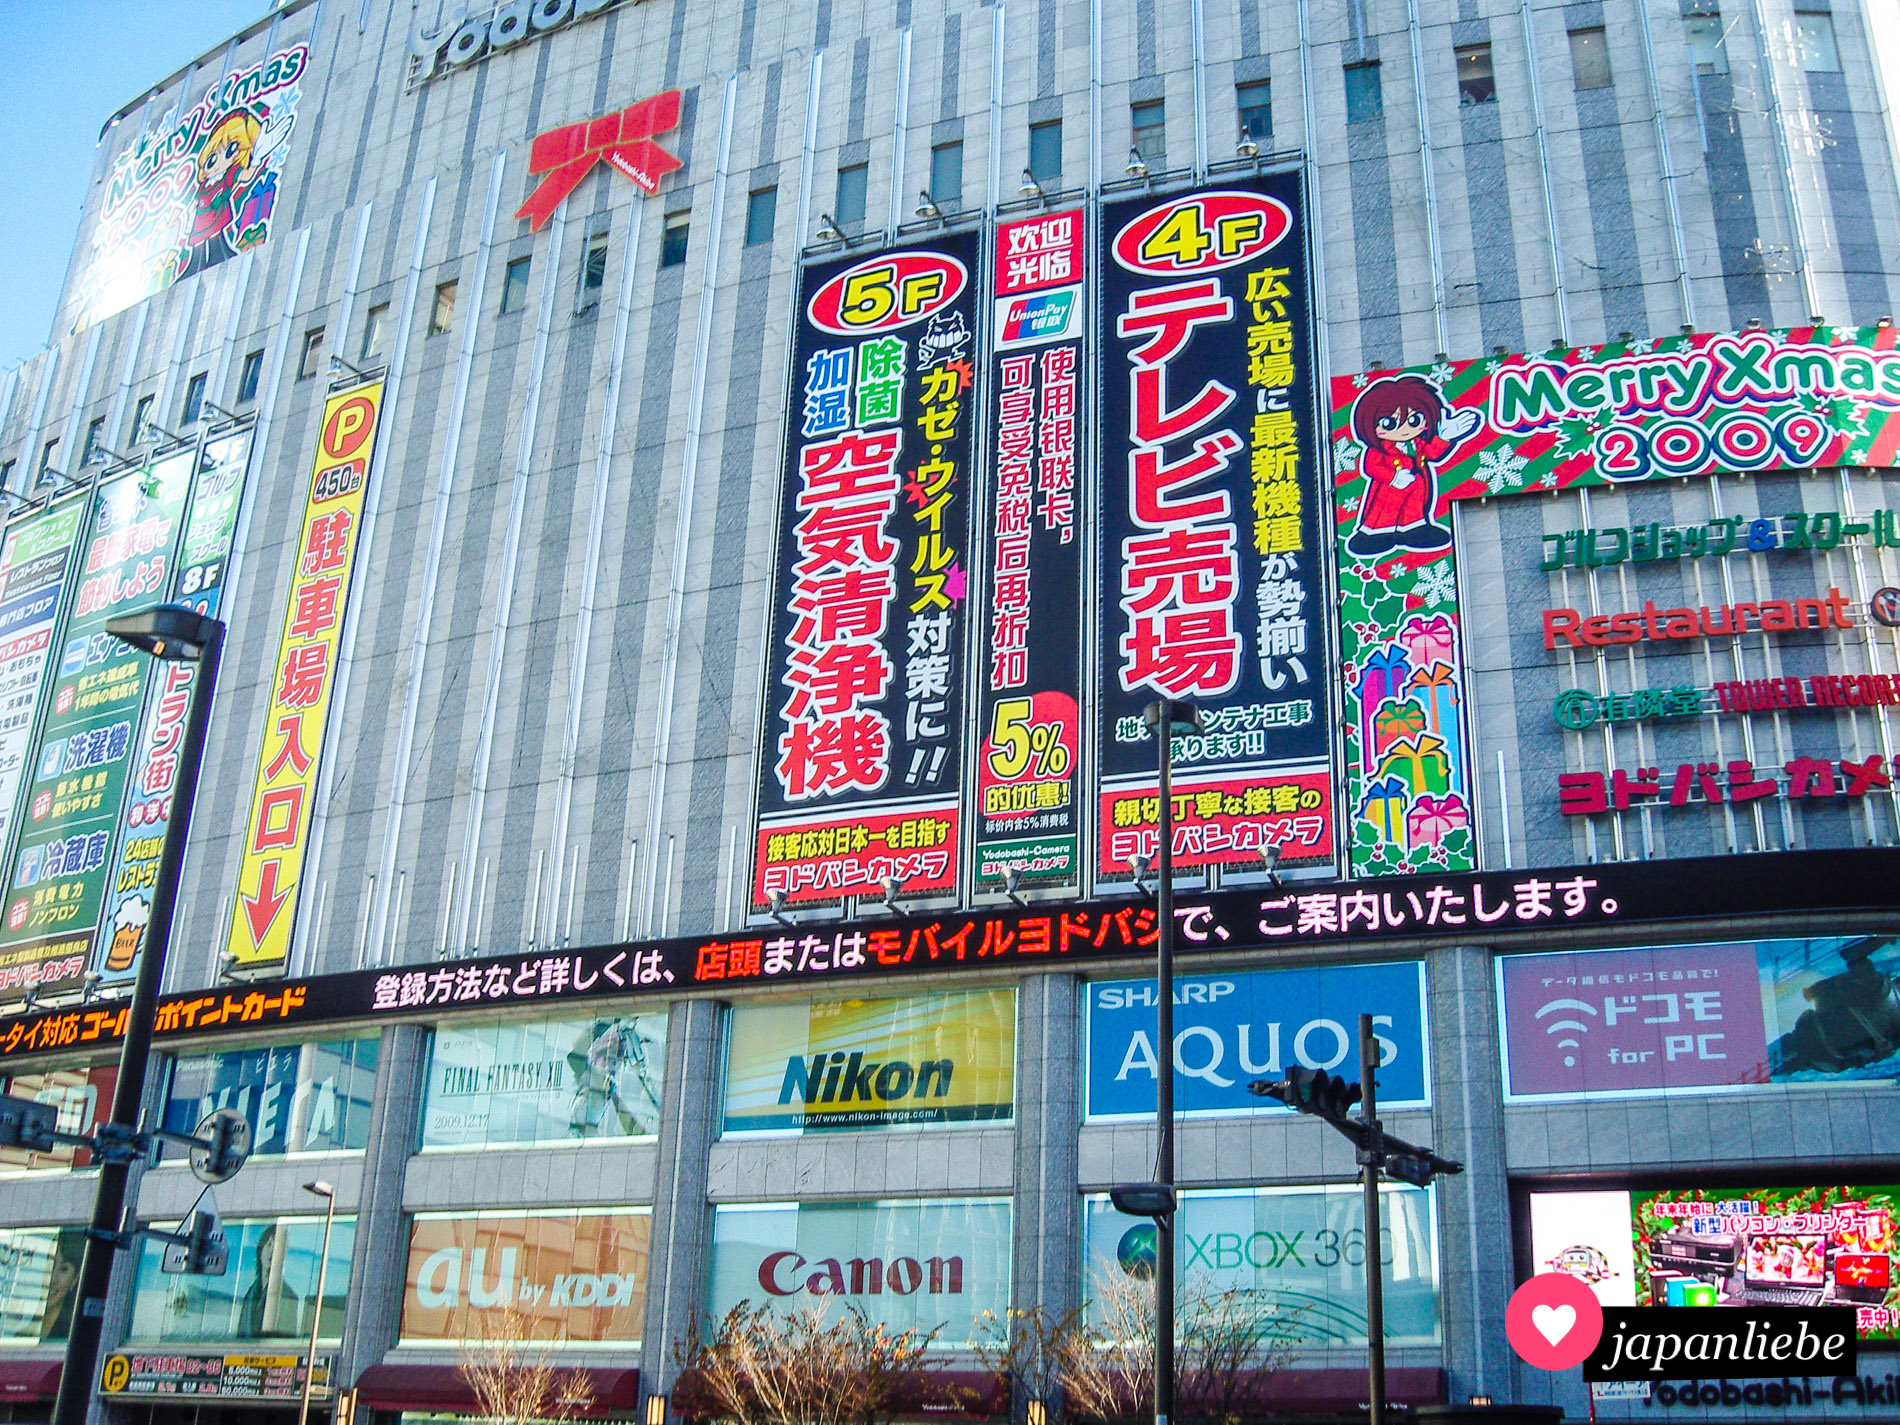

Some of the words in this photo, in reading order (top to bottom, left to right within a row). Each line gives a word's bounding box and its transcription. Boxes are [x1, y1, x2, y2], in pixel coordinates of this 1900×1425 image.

[407, 0, 612, 81] Yodo
[103, 109, 204, 216] Merry
[203, 46, 306, 129] Xmas
[1008, 216, 1072, 256] 欢迎
[1141, 203, 1263, 265] 4F
[1007, 250, 1071, 288] 光临
[838, 267, 947, 326] 5F
[1009, 302, 1068, 323] UnionPay
[802, 348, 853, 437] 加湿
[857, 336, 906, 428] 除菌
[1495, 357, 1712, 430] Merry
[332, 404, 366, 453] P
[1598, 414, 1830, 475] 2009
[1118, 278, 1243, 699] テレビ売場
[1245, 267, 1308, 690] 広い売場に最新機種が勢揃い
[991, 354, 1035, 690] 可享受免税后再折扣
[182, 562, 220, 596] 8F
[777, 431, 901, 799] 空気清浄機
[1543, 588, 1854, 650] Restaurant
[252, 508, 353, 854] 駐車場入口
[1602, 686, 1703, 722] 有隣堂
[1713, 677, 1807, 713] TOWER
[63, 720, 131, 774] 洗濯機
[988, 697, 1069, 779] 5%
[984, 779, 1071, 815] 的优惠!
[1113, 785, 1322, 826] 親切丁寧な接客の
[1559, 754, 1900, 815] ヨドバシカメ
[767, 820, 951, 863] 接客応対日本一を目指す
[985, 812, 1069, 833] 标价内含5%消费税
[41, 830, 110, 881] 冷蔵庫
[124, 836, 166, 863] 24店舗
[764, 851, 948, 893] ヨドバシカメラ
[983, 845, 1070, 859] Yodobashi-Camera
[117, 861, 160, 893] レストラ
[28, 904, 80, 928] ノンフロン
[1604, 991, 1723, 1026] ドコモ
[176, 1053, 224, 1072] Panasonic
[255, 1052, 292, 1073] ビエラ
[1114, 1015, 1398, 1088] AQUOS
[1607, 1048, 1654, 1064] for
[1665, 1033, 1727, 1062] PC
[443, 1065, 480, 1094] FINAL
[486, 1061, 543, 1092] FANTASY
[547, 1060, 564, 1088] XIII
[777, 1050, 955, 1105] Nikon
[792, 1107, 938, 1125] http://www.nikon-image.com/
[1653, 1201, 1713, 1218] 年末年始に
[1692, 1214, 1869, 1236] 新型パソコン・プリンター
[1185, 1230, 1307, 1270] XBOX
[416, 1246, 517, 1310] au
[519, 1276, 547, 1308] by
[549, 1273, 636, 1307] KDDI
[758, 1251, 963, 1297] Canon
[1643, 1374, 1900, 1407] odobashi-Aki
